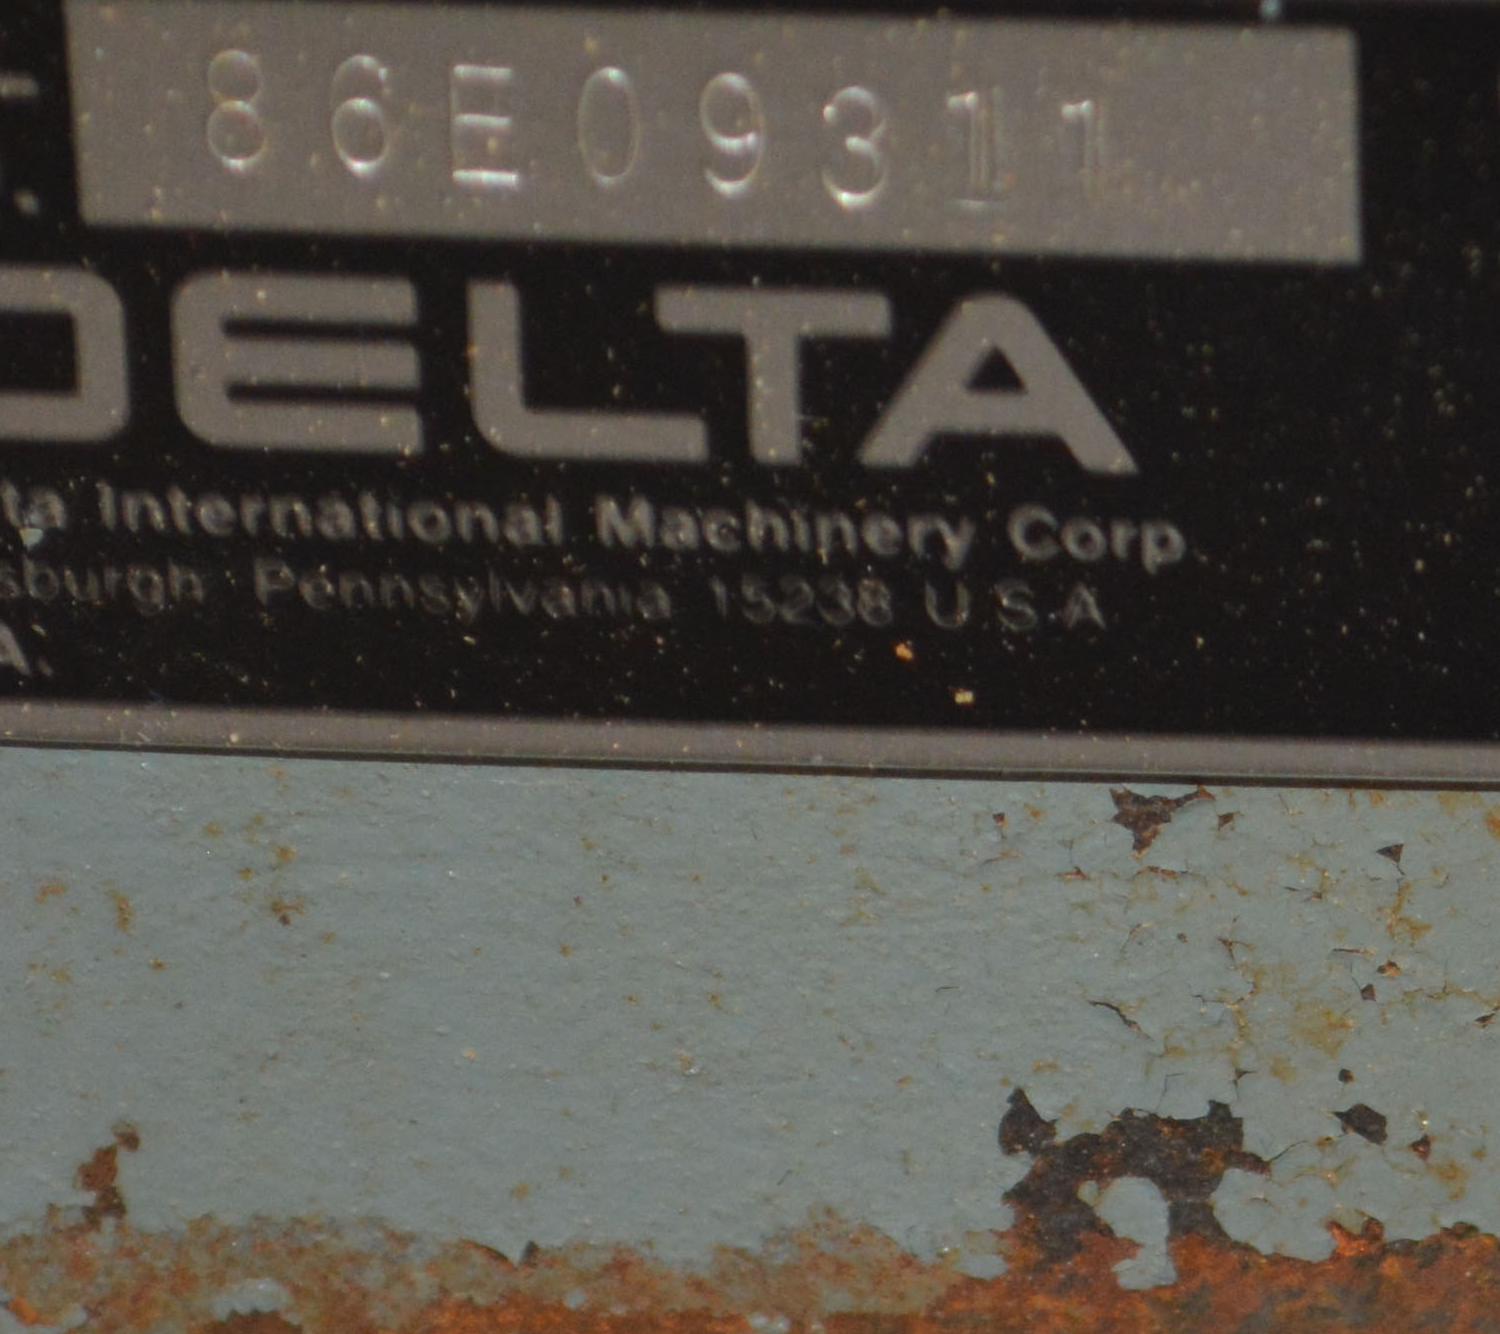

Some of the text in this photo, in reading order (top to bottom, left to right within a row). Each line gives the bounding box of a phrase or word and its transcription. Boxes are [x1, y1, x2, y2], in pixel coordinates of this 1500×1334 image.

[97, 480, 562, 549] International
[596, 495, 976, 572] Machinery
[254, 555, 672, 629] Pennsylvania
[710, 575, 894, 627] 15238
